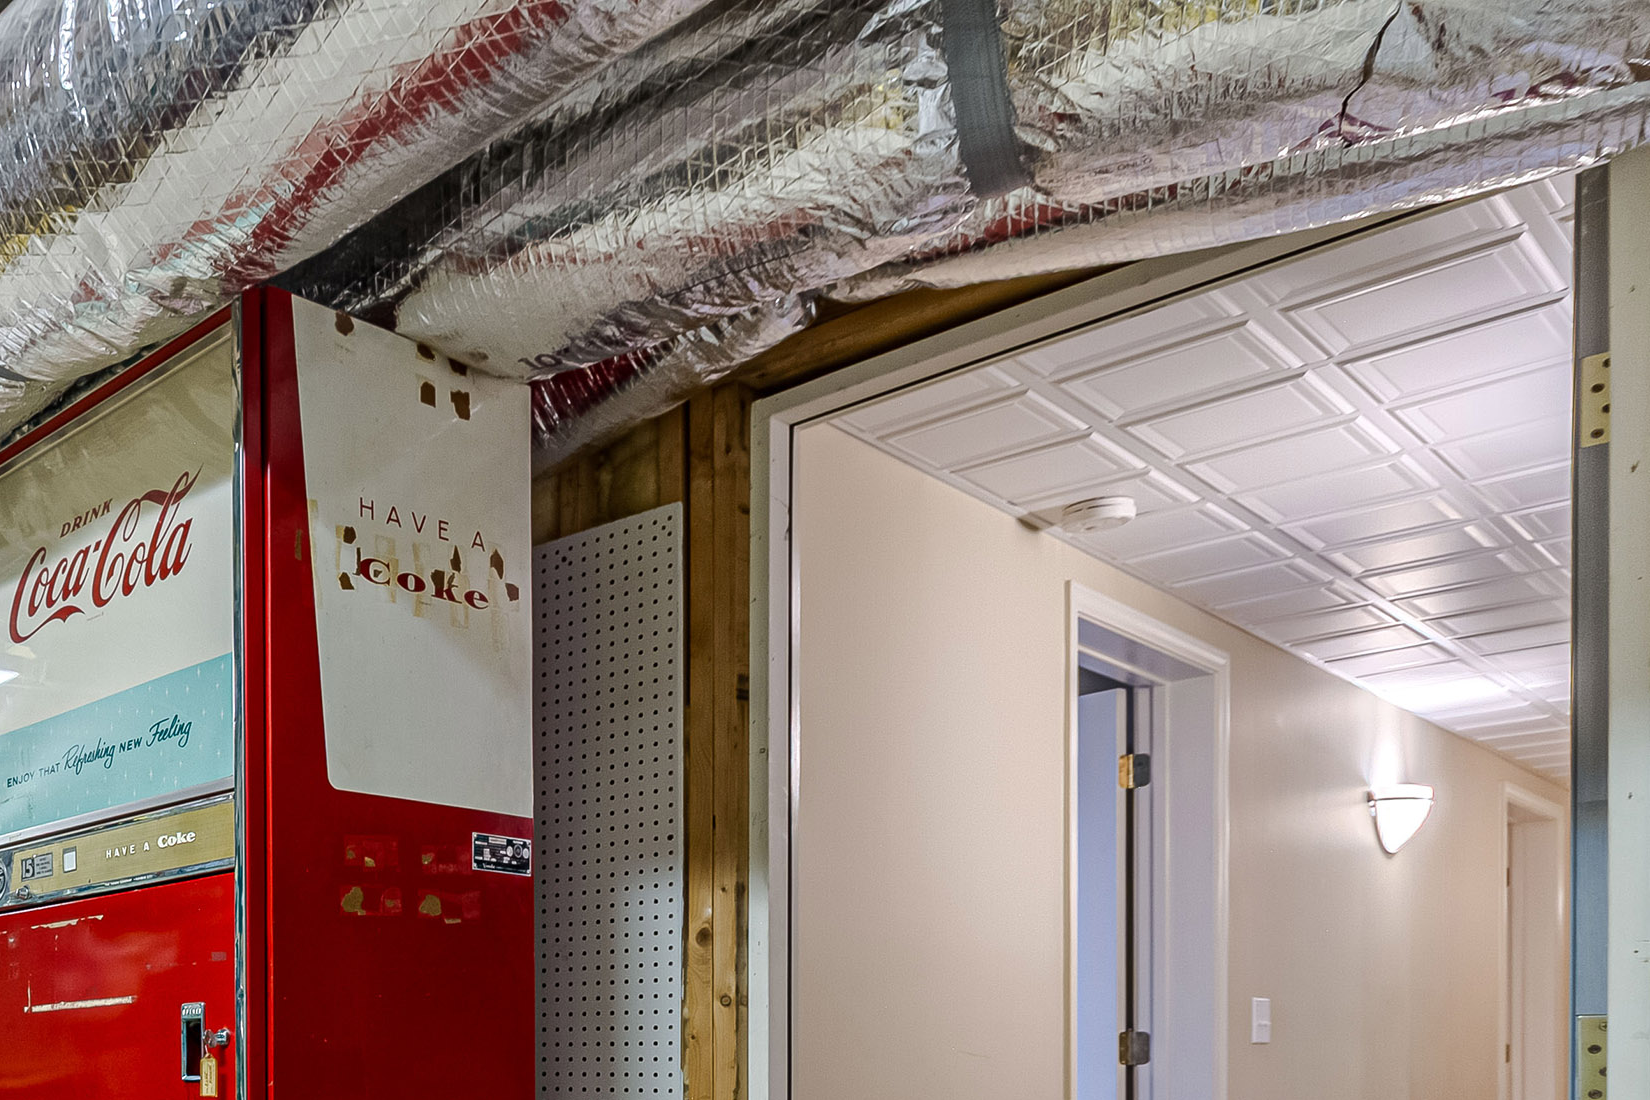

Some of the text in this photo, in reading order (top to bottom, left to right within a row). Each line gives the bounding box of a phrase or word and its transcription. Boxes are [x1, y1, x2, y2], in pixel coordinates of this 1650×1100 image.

[59, 498, 113, 539] DRINK
[359, 496, 485, 552] HAVE A
[9, 462, 204, 644] Coca-Cola
[359, 557, 490, 610] Coke
[6, 714, 193, 788] ENJOY THAT Refreshing NEW Feeling
[105, 830, 197, 859] HAVE A Coke
